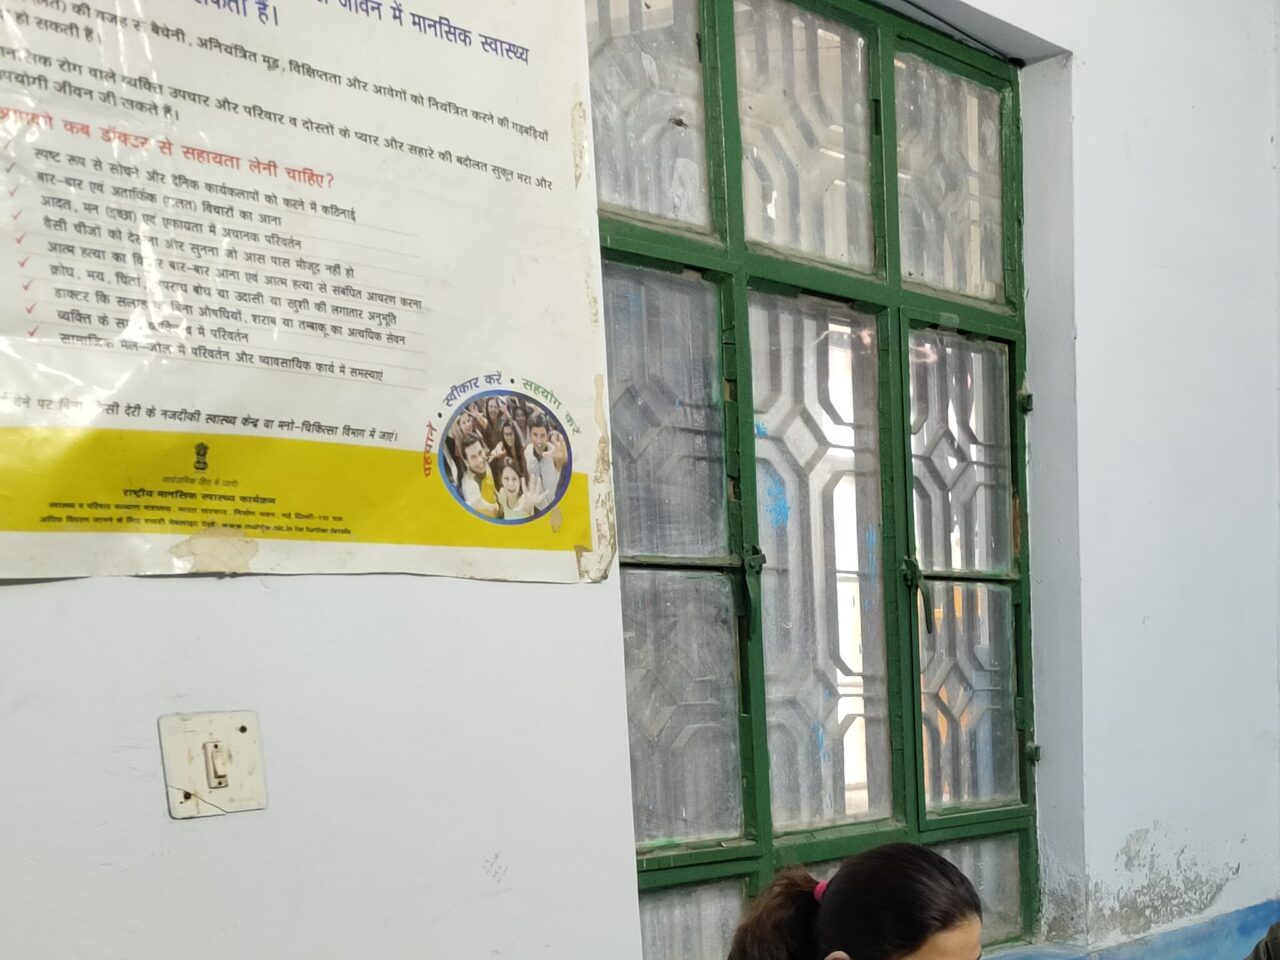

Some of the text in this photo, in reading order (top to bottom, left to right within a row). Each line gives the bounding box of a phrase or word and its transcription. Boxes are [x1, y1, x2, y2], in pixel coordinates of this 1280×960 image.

[35, 16, 79, 39] सकती
[390, 0, 403, 26] में
[409, 12, 472, 47] मानसिक
[479, 33, 530, 65] स्वास्थ्य
[53, 80, 159, 116] जीवन सकते
[346, 75, 368, 92] और
[410, 92, 424, 107] को
[471, 110, 495, 125] करने
[497, 115, 509, 130] की
[56, 58, 82, 75] रोग
[215, 97, 240, 115] और
[243, 104, 285, 124] परिवार
[288, 115, 297, 127] व
[338, 125, 351, 139] के
[355, 131, 380, 146] प्यार
[383, 136, 404, 152] और
[407, 143, 435, 159] सहारे
[438, 150, 453, 163] की
[517, 172, 532, 185] भरा
[535, 176, 553, 190] और
[62, 119, 91, 138] कब
[158, 138, 173, 156] से
[181, 145, 240, 170] सहायता
[248, 157, 279, 177] लेनी
[91, 158, 103, 171] से
[146, 168, 166, 184] और
[264, 192, 278, 205] को
[282, 197, 305, 211] करने
[239, 209, 253, 222] का
[258, 213, 282, 227] आना
[222, 227, 302, 250] अचानक परिवर्तन
[48, 241, 75, 256] आत्म
[216, 268, 240, 282] आना
[264, 275, 288, 288] आत्म
[400, 297, 422, 310] करना
[244, 250, 266, 265] आस
[271, 255, 291, 268] पास
[331, 304, 364, 320] लगातार
[235, 350, 254, 365] और
[442, 377, 480, 407] स्वीकार
[484, 370, 503, 385] करें
[521, 377, 563, 409] सहयोग
